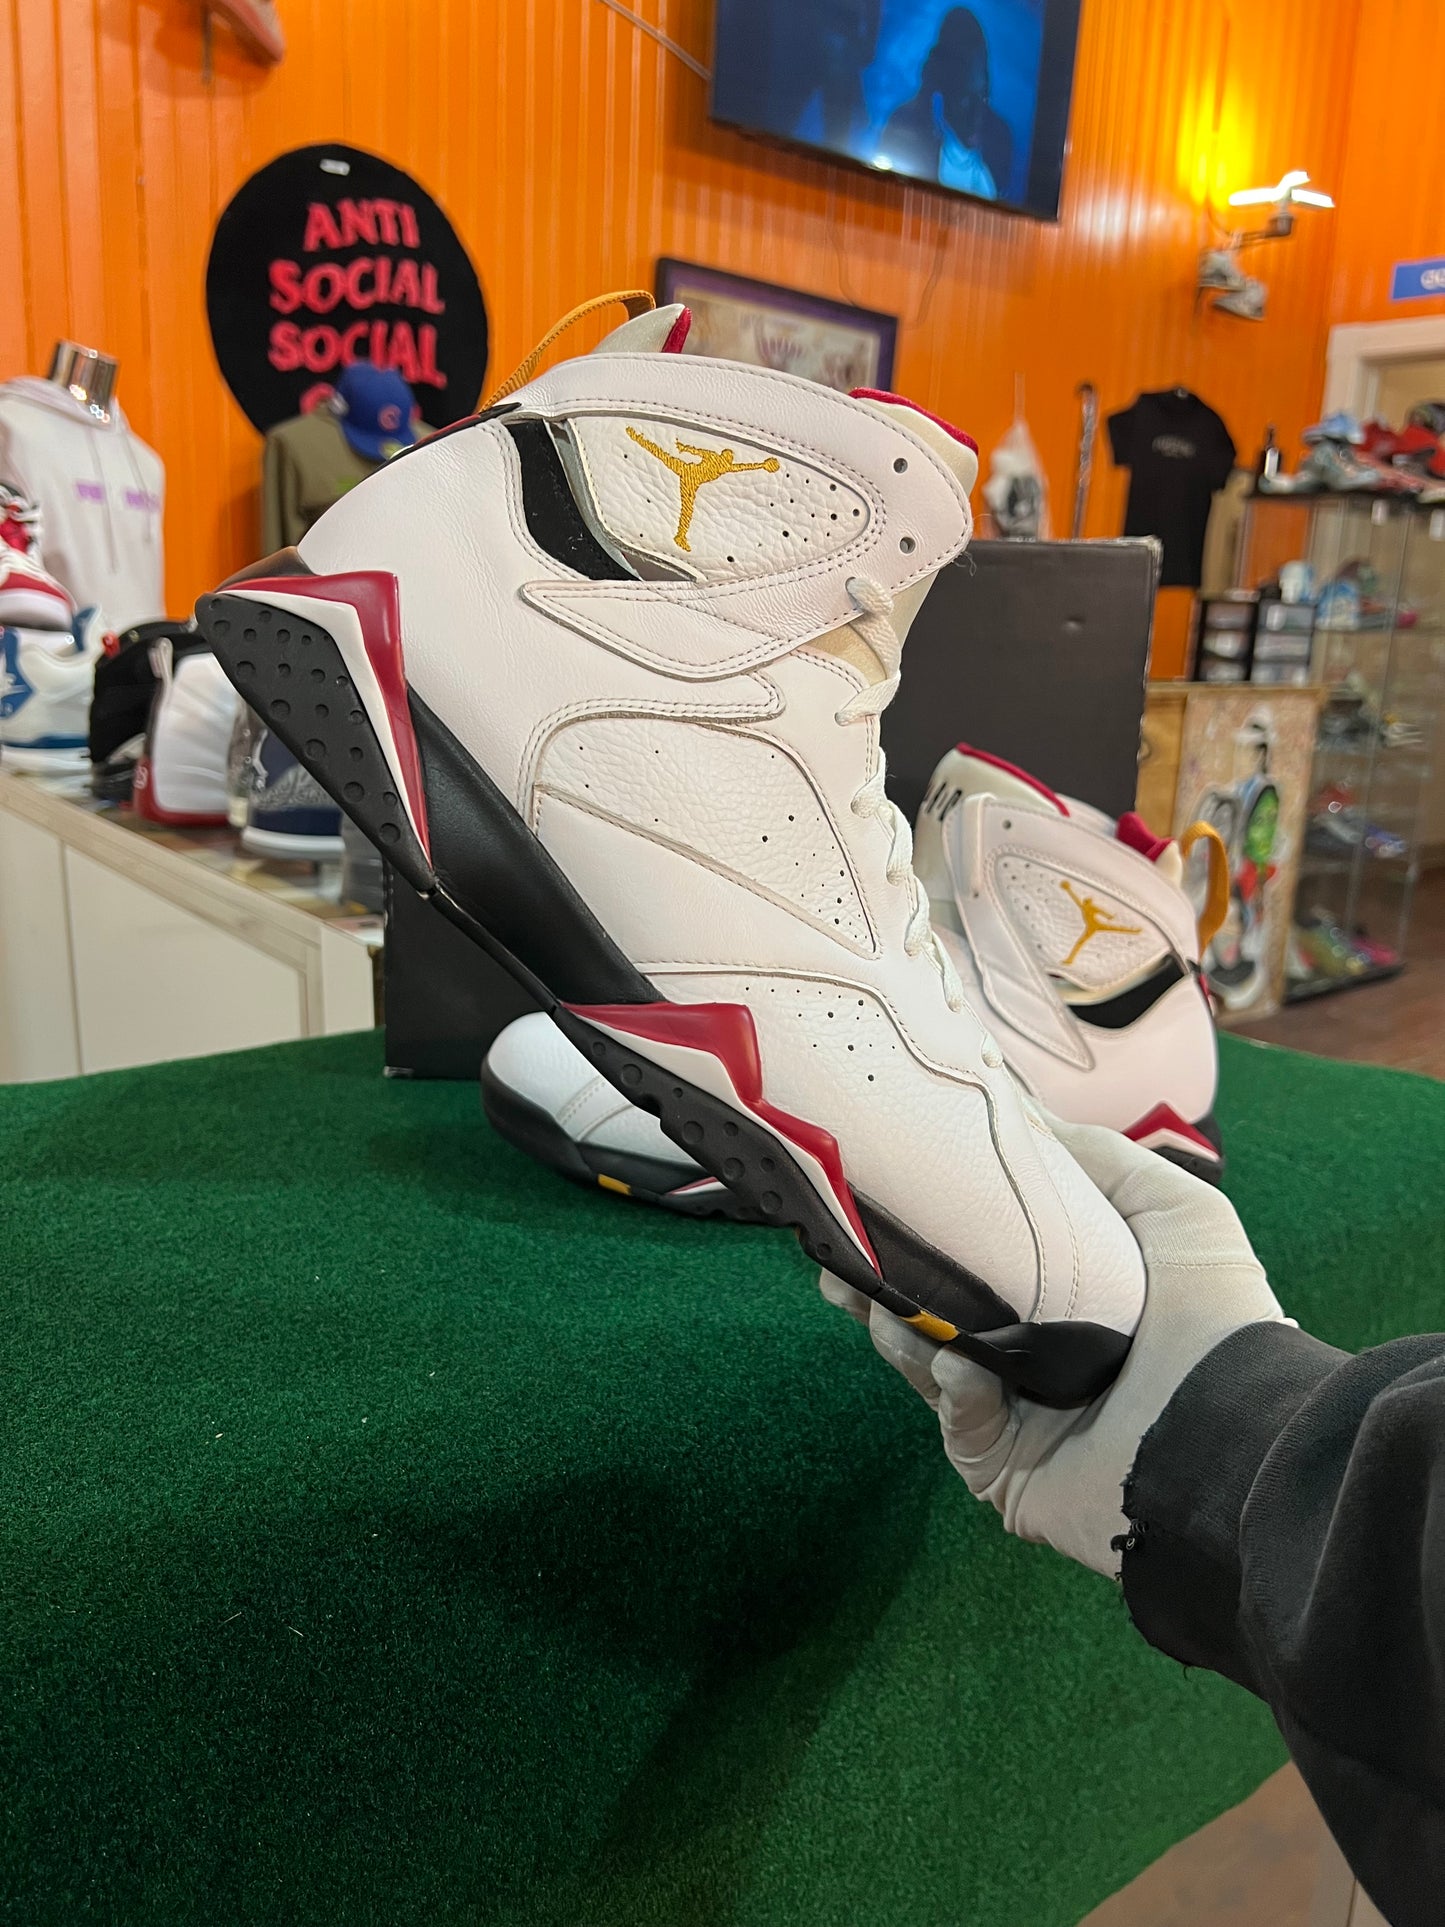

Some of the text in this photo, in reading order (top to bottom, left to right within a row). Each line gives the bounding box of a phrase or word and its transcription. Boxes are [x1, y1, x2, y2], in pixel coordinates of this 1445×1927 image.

[304, 198, 420, 251] ANTI
[268, 256, 445, 315] SOCIAL
[267, 319, 447, 389] SOCIAL
